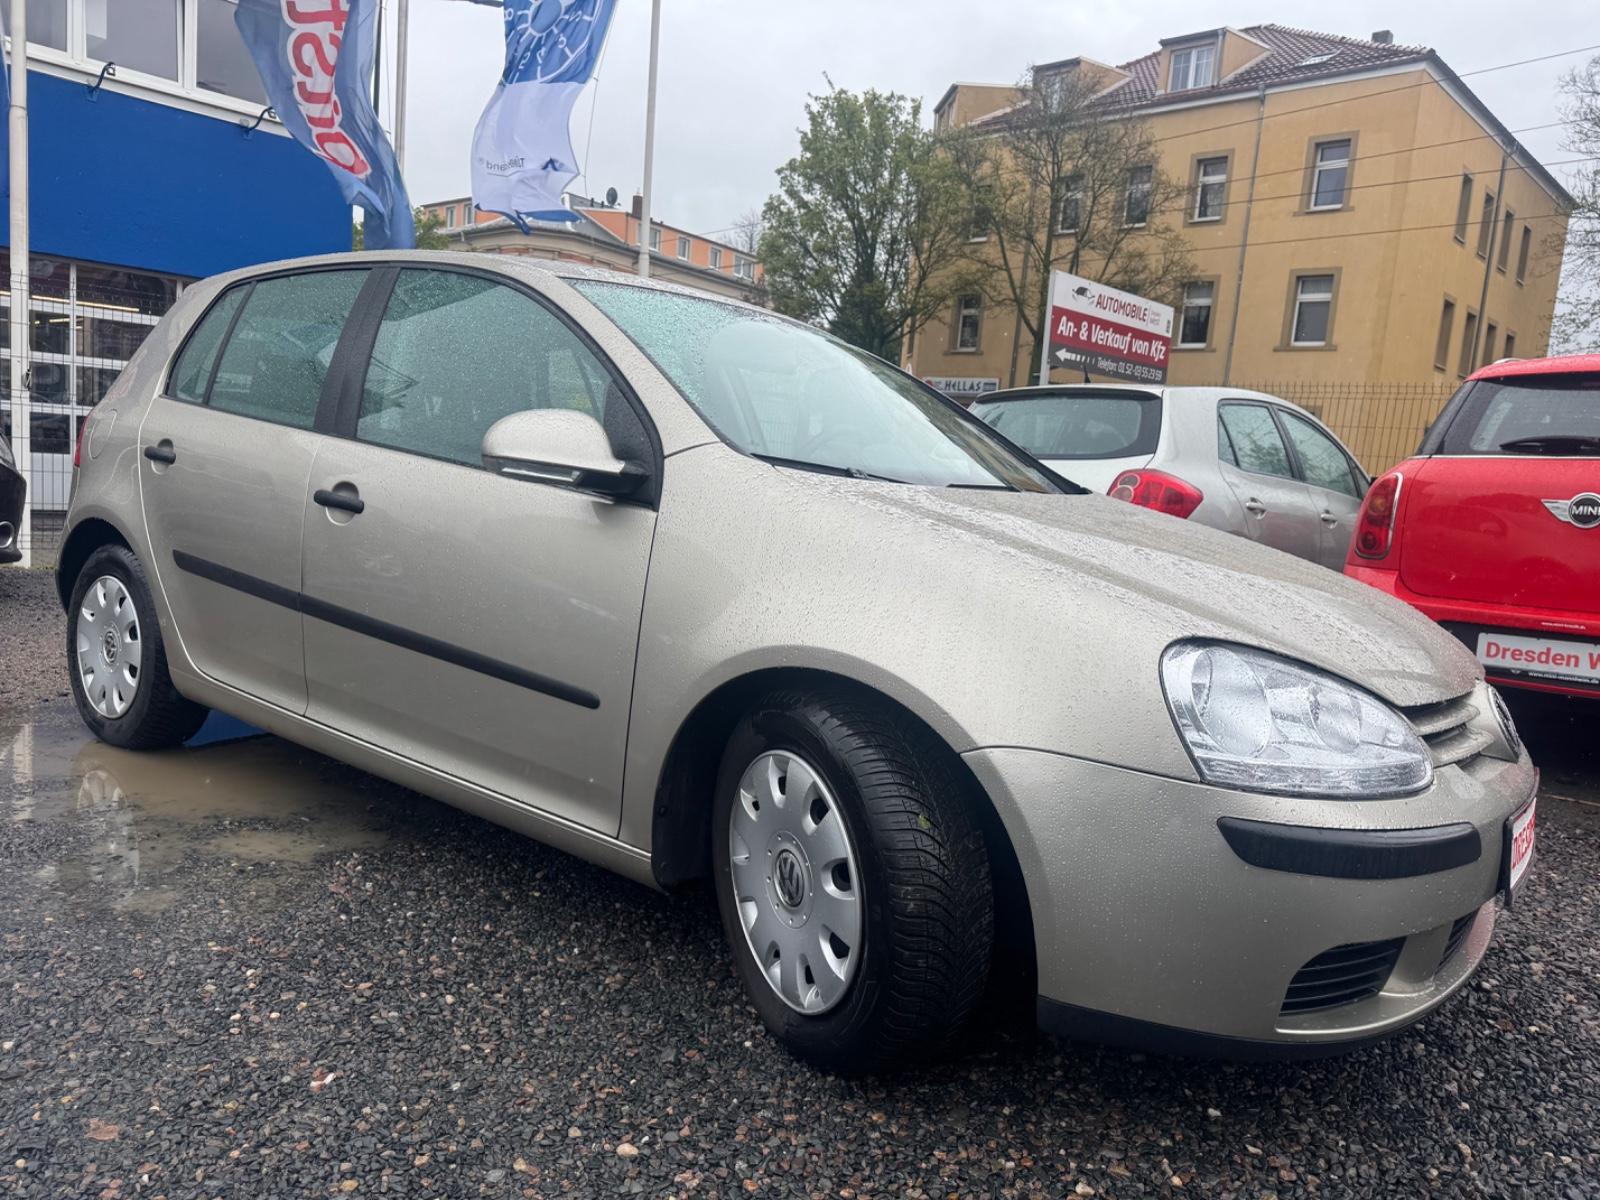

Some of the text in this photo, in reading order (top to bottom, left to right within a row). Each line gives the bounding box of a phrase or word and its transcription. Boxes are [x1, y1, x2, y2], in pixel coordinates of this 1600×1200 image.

[1096, 294, 1148, 322] AUTOMOBILE
[1057, 315, 1167, 362] An- & Verkauf von Kfz
[1486, 641, 1580, 668] Dresden
